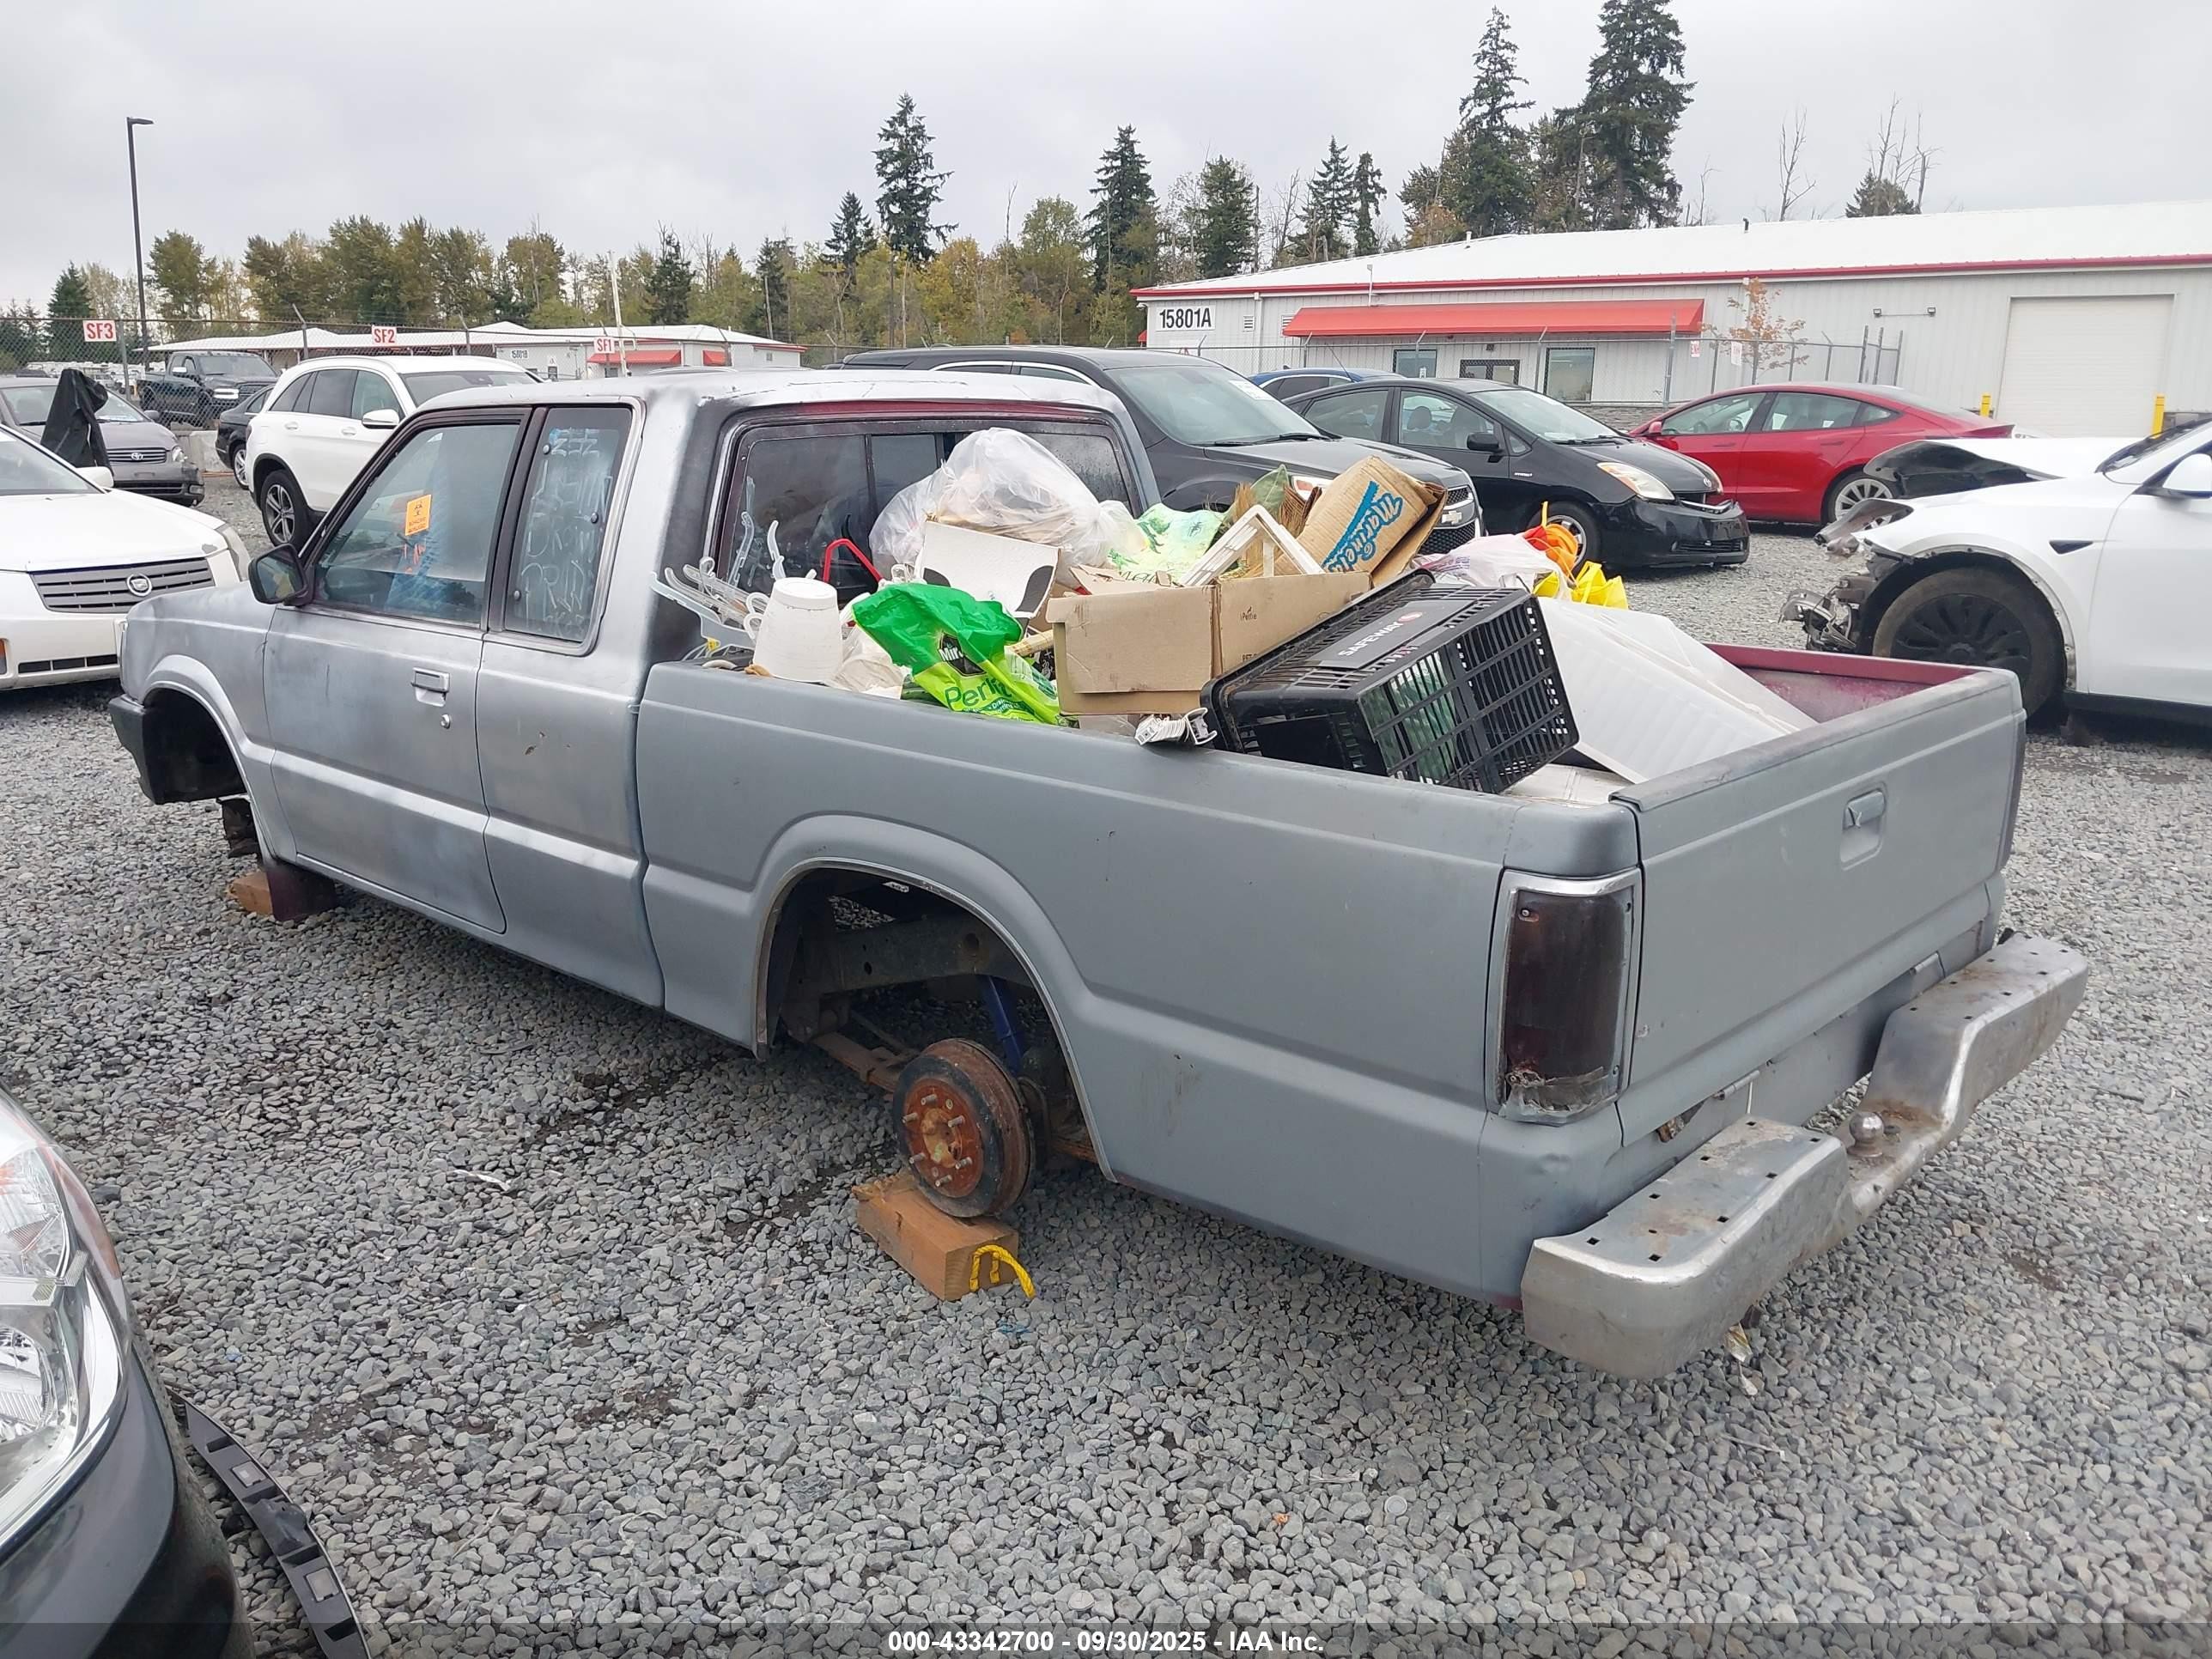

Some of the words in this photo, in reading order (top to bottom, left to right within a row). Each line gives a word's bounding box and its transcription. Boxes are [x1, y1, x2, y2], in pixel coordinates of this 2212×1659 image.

[1159, 307, 1212, 328] 15801A
[86, 323, 114, 339] SF3
[374, 328, 396, 343] SF2
[597, 339, 612, 352] SF1
[1338, 621, 1404, 656] SAFEWAY
[945, 678, 1012, 712] Perlit
